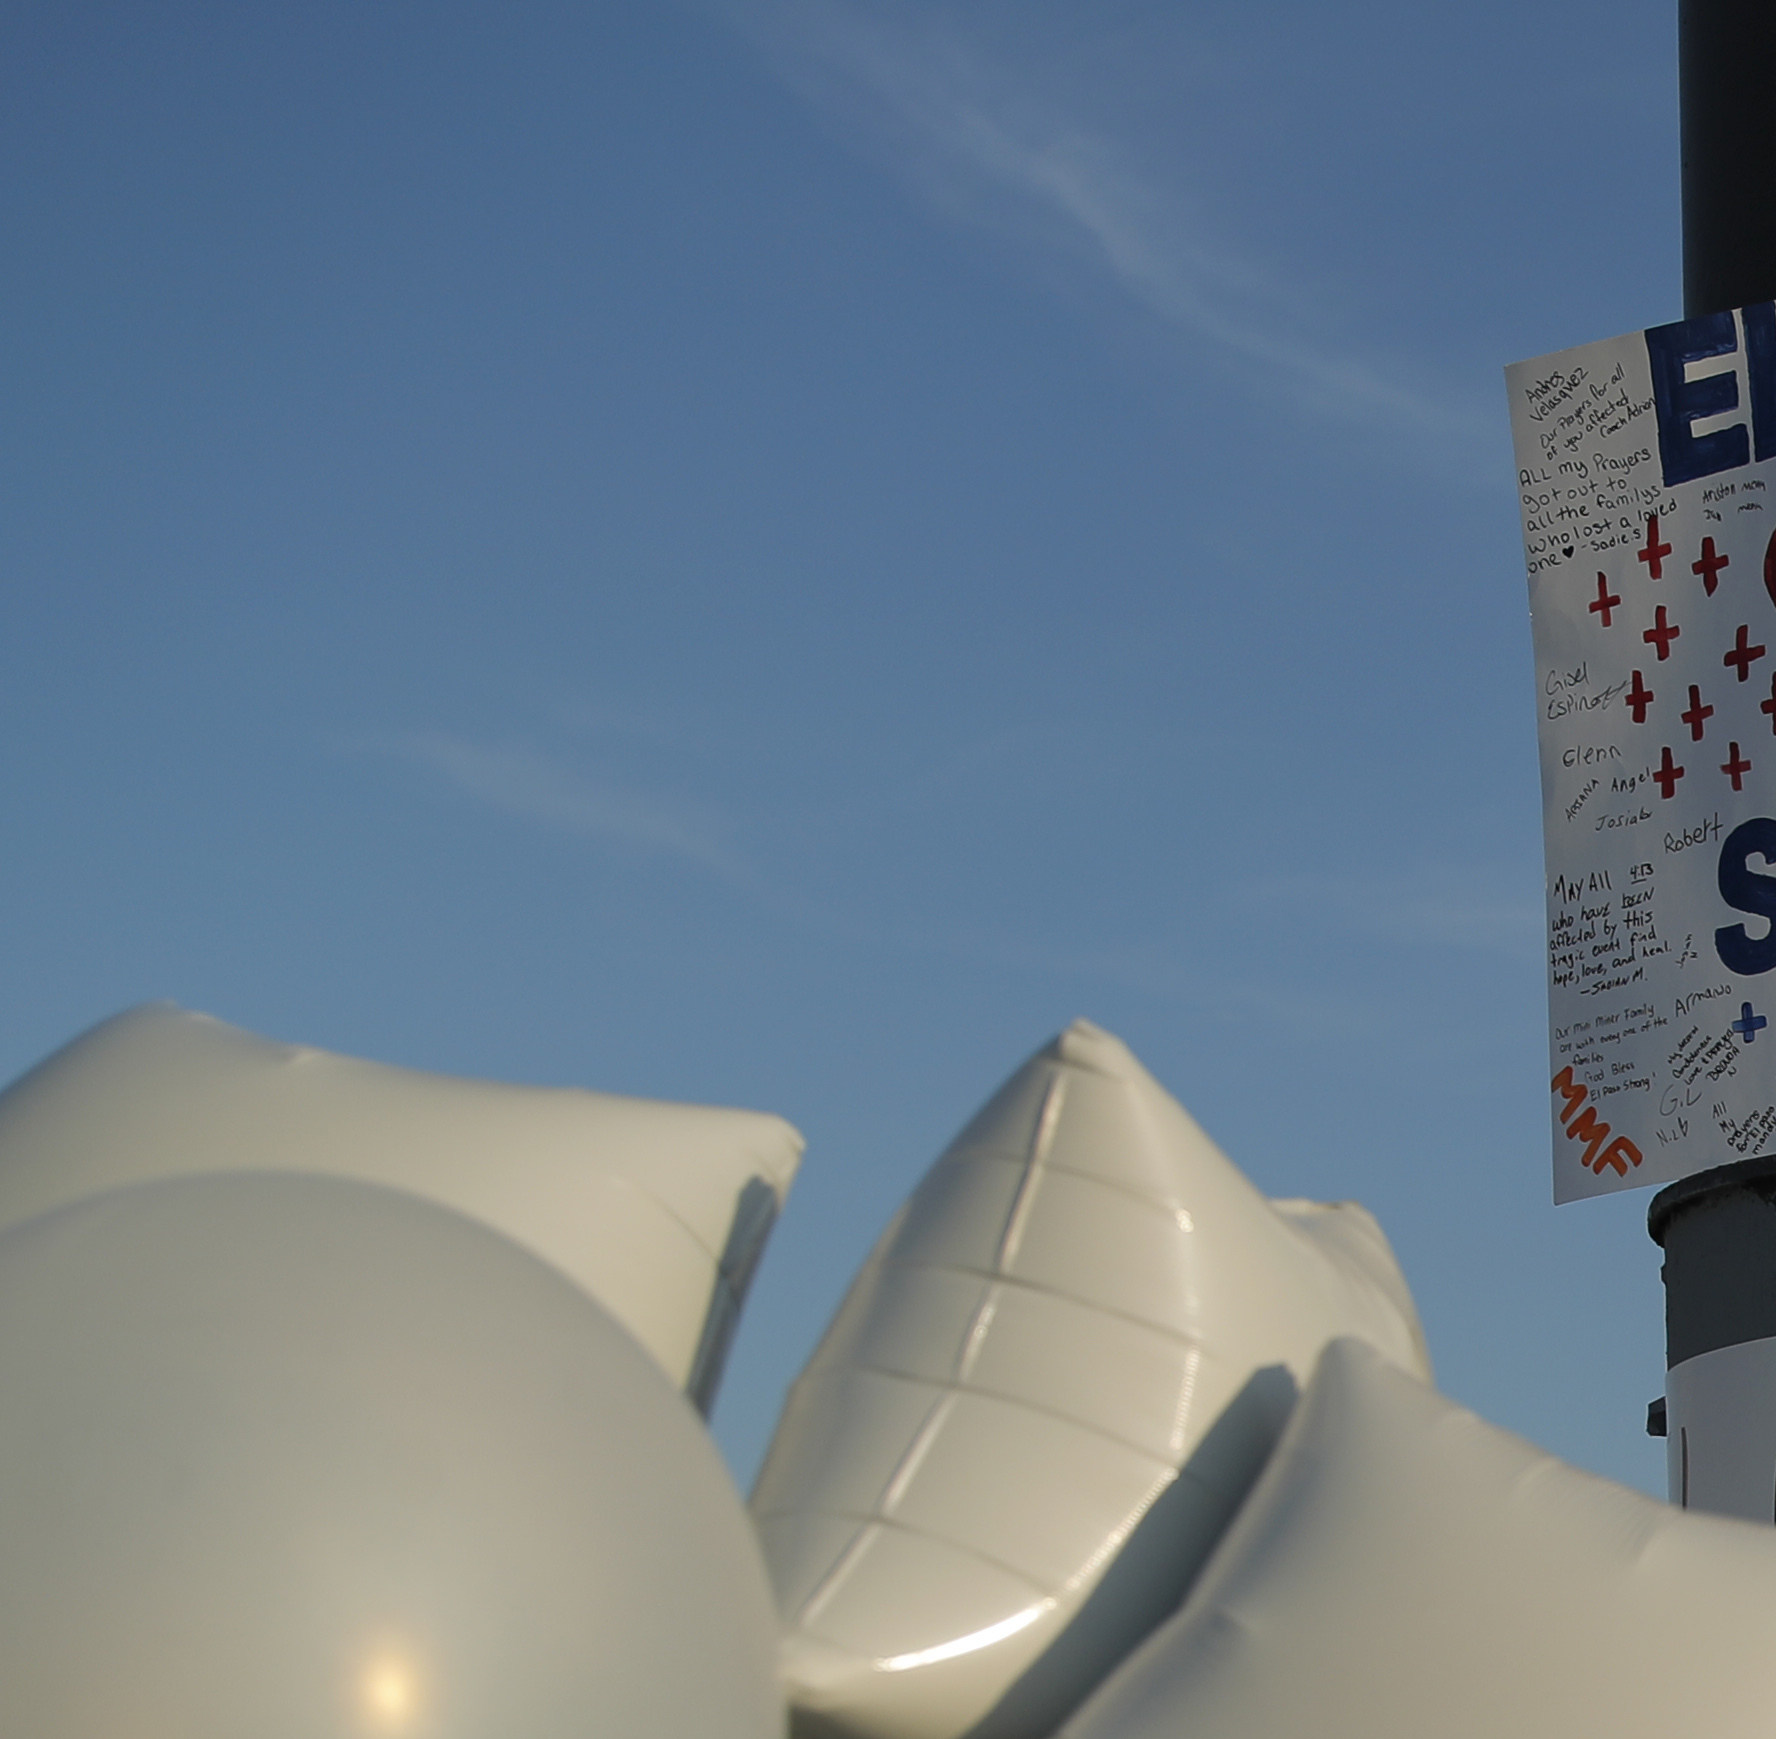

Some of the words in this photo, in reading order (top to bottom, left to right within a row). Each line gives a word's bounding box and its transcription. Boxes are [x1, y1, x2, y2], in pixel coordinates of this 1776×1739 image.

[1610, 362, 1626, 386] all
[1519, 468, 1552, 488] ALL
[1558, 460, 1589, 479] my
[1593, 448, 1652, 475] Prayers
[1567, 480, 1600, 500] out
[1606, 476, 1628, 491] to
[1527, 513, 1554, 533] all
[1556, 505, 1591, 526] the
[1527, 533, 1571, 555] who
[1574, 519, 1613, 541] lost
[1619, 517, 1633, 529] a
[1637, 498, 1678, 523] loved
[1527, 554, 1562, 575] one
[1611, 766, 1650, 794] Angel
[1663, 812, 1724, 854] Robert
[1622, 910, 1655, 930] this
[1612, 952, 1636, 970] and
